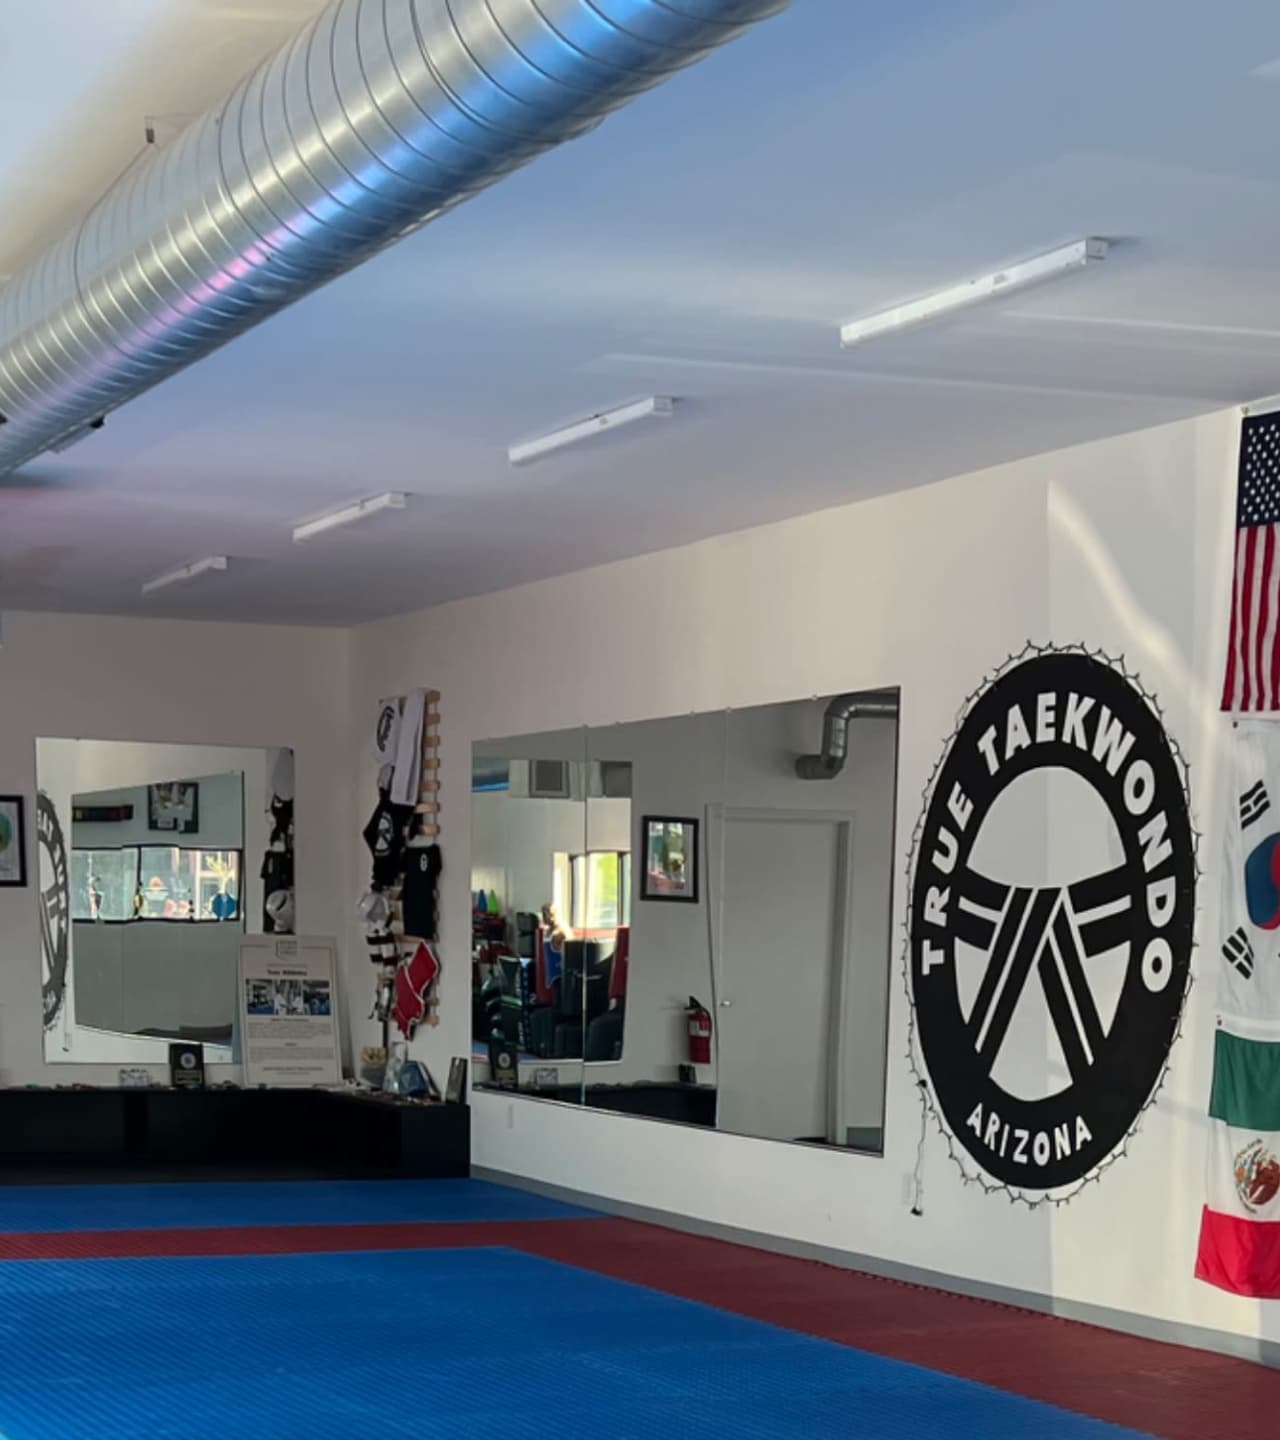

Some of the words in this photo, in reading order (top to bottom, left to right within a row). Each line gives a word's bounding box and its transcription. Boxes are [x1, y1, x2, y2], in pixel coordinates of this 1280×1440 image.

[923, 782, 974, 976] TRUE
[978, 692, 1175, 993] TAEKWONDO
[967, 1104, 1092, 1166] ARIZONA
